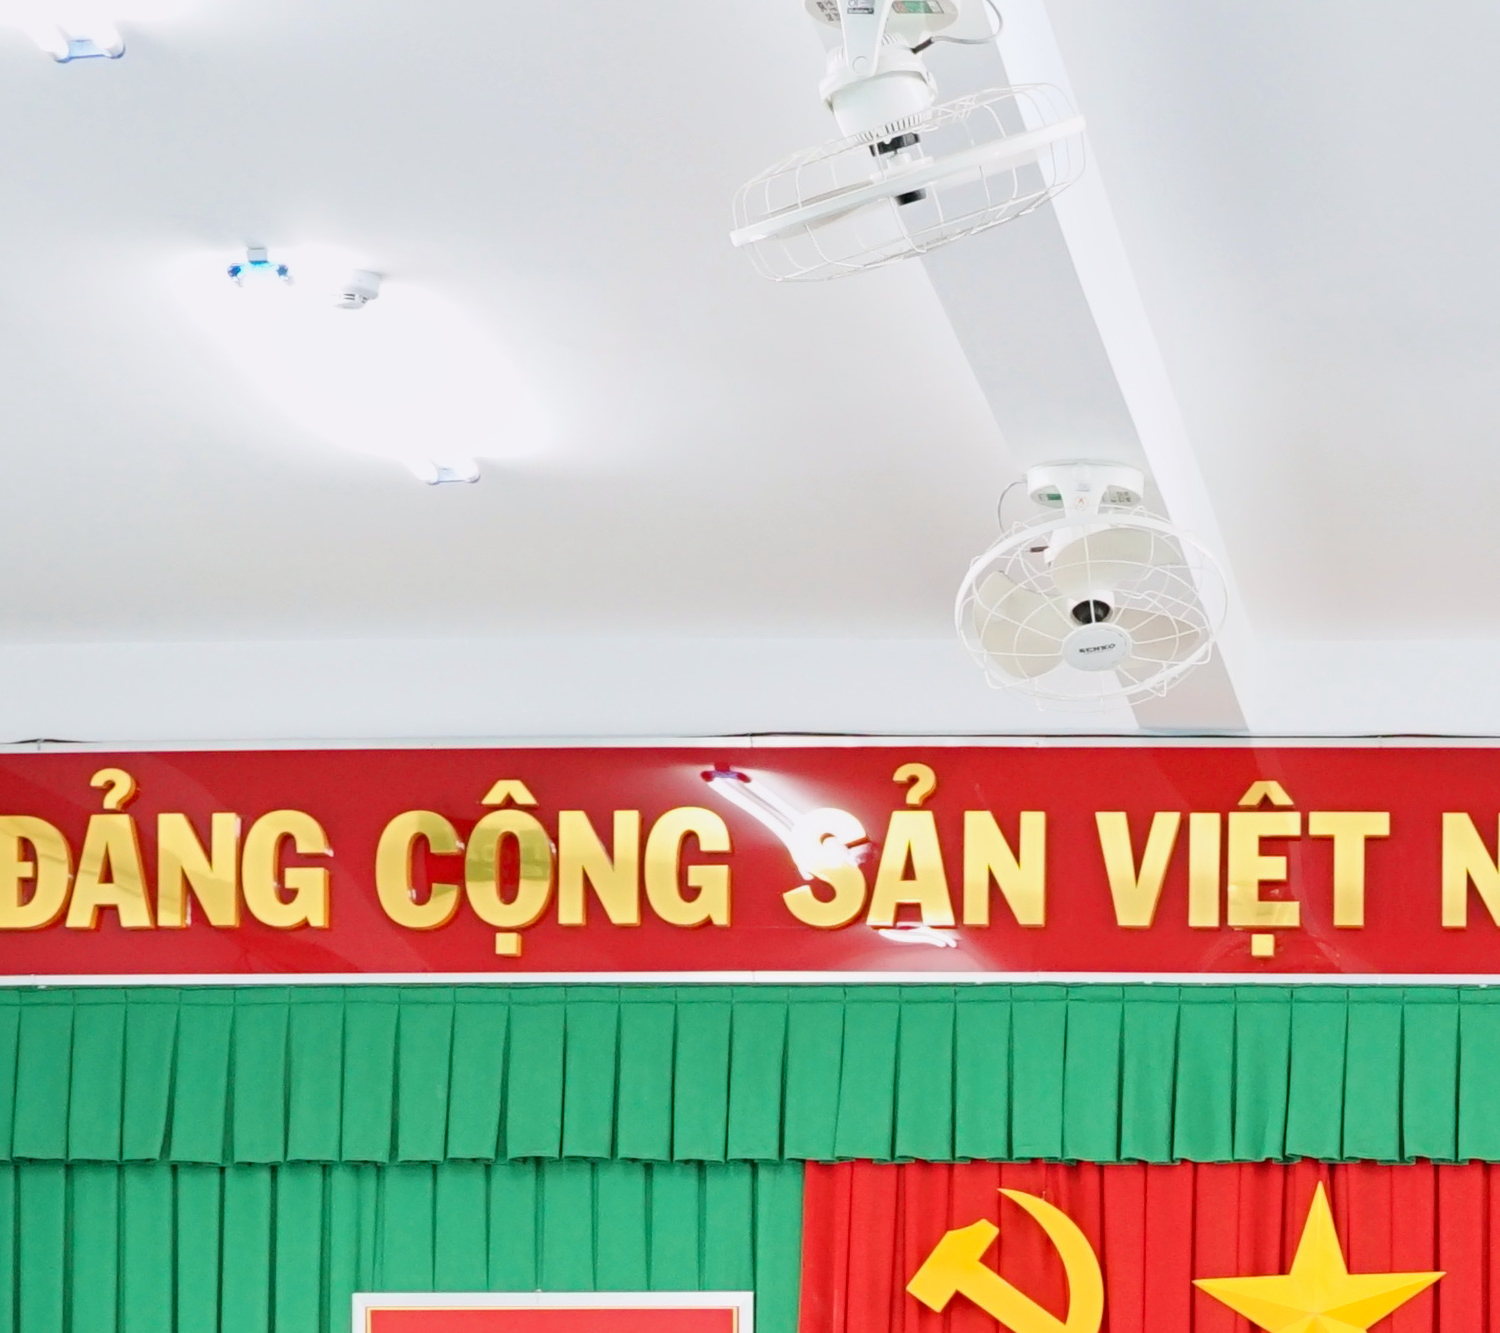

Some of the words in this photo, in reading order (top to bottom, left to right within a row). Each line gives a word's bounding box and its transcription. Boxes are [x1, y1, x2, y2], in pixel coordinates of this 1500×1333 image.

[375, 779, 733, 957] CỘNG
[782, 763, 1047, 928] SẢN
[1095, 780, 1391, 957] VIỆT
